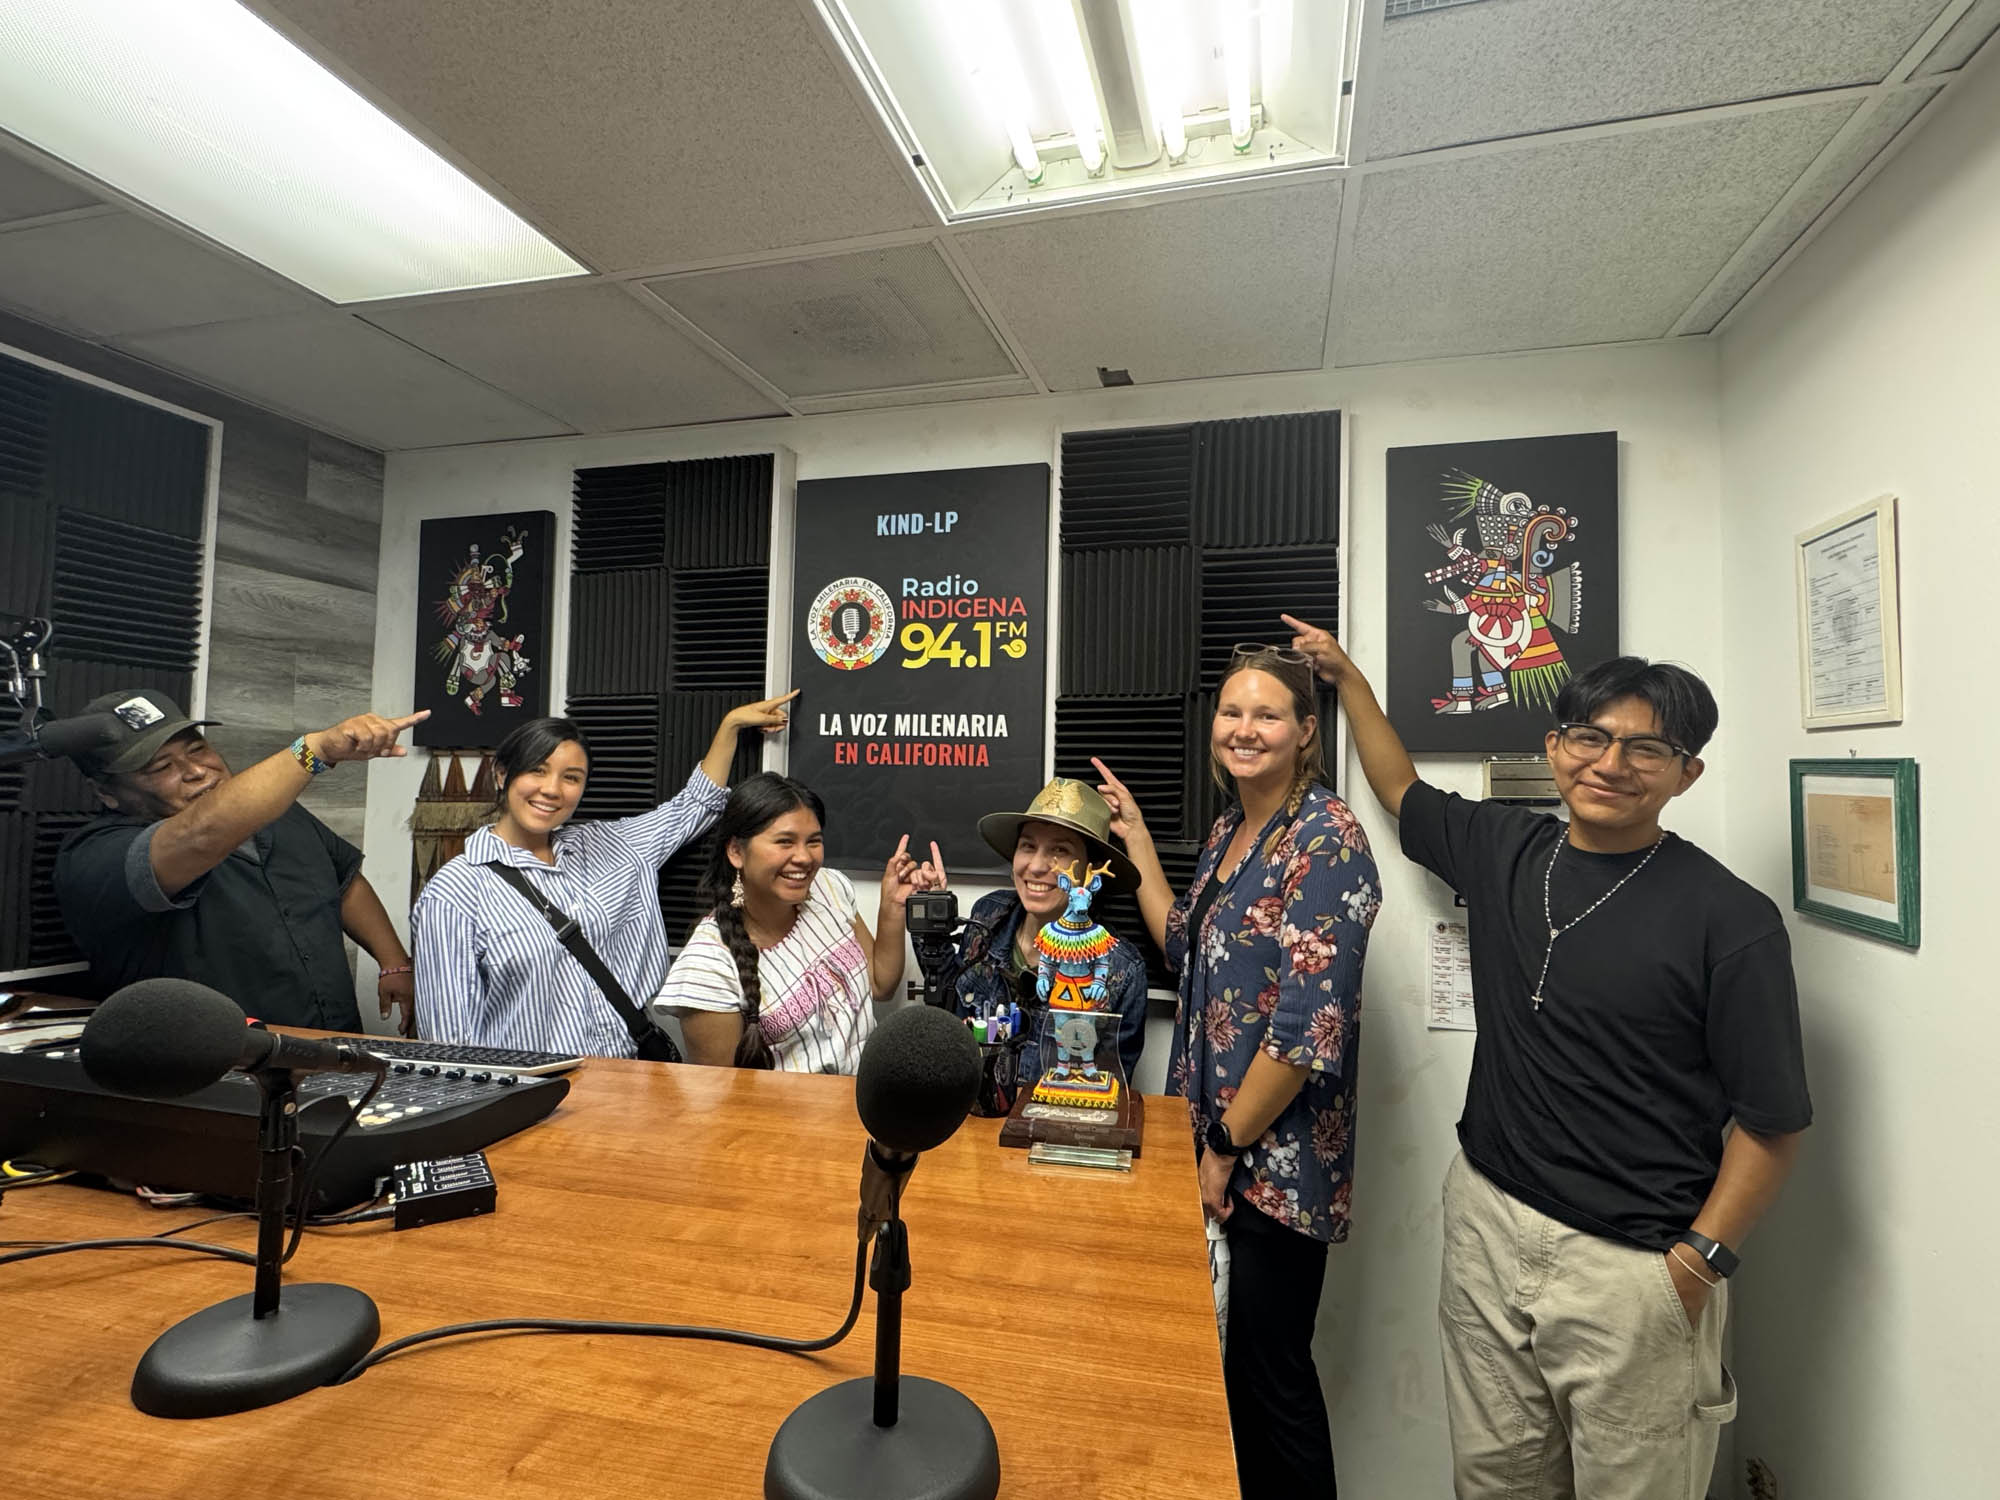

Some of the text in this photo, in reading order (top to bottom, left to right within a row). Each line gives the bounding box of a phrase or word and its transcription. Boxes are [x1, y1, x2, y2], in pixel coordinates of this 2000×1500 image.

[876, 511, 959, 536] KIND-LP
[902, 574, 979, 597] Radio
[809, 579, 894, 641] LA VOZ MILENARIA EN CALIFORNIA
[901, 597, 1028, 620] INDIGENA
[900, 621, 1028, 669] 94.1 FM
[819, 713, 1009, 738] LA VOZ MILENARIA
[835, 742, 990, 767] EN CALIFORNIA
